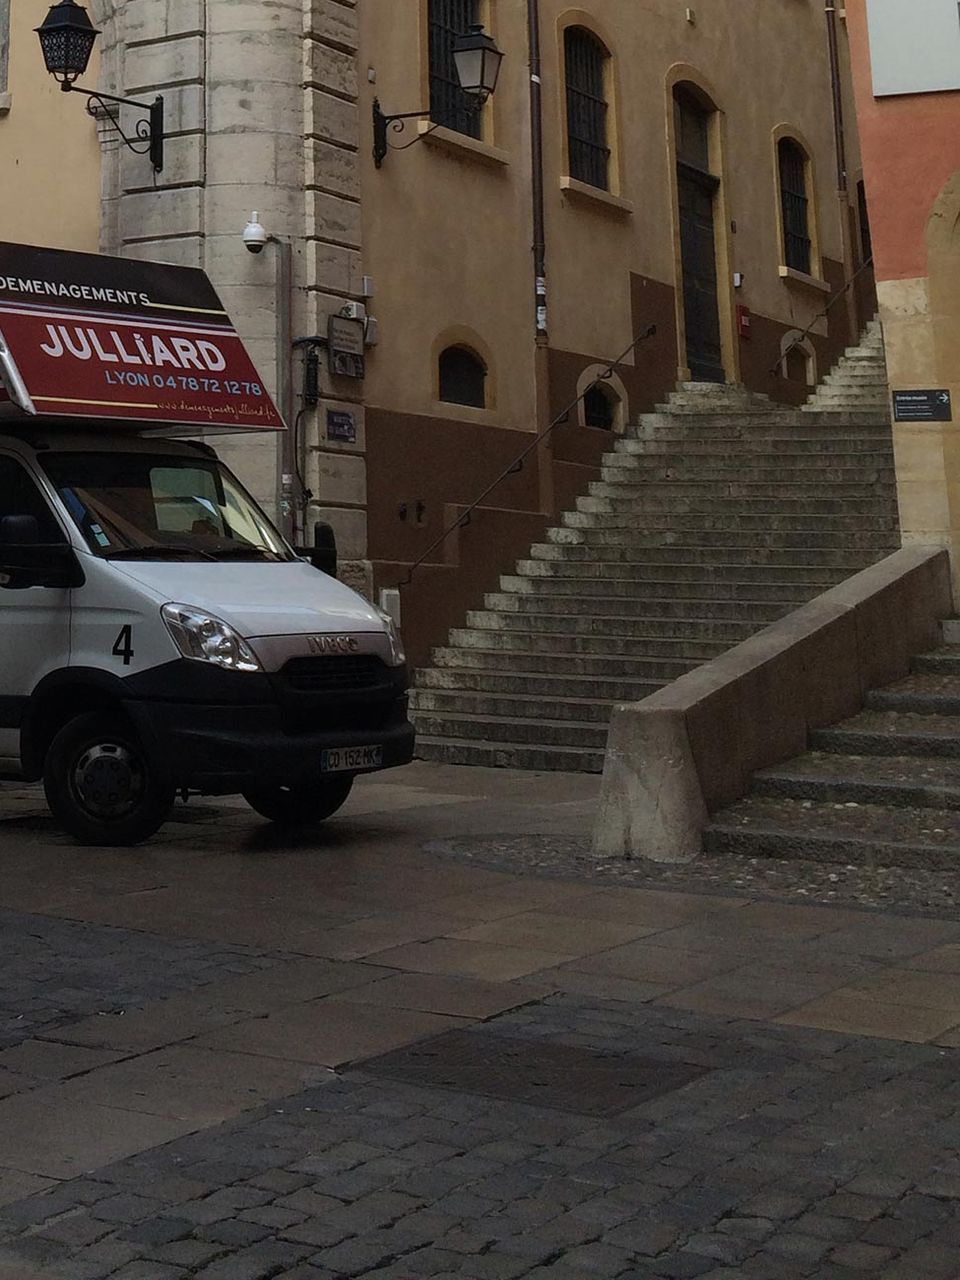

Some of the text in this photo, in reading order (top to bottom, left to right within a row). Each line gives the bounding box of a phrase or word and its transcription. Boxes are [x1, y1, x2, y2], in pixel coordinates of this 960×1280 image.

[105, 369, 150, 389] LYON
[112, 624, 135, 666] 4
[306, 635, 360, 654] IVECO
